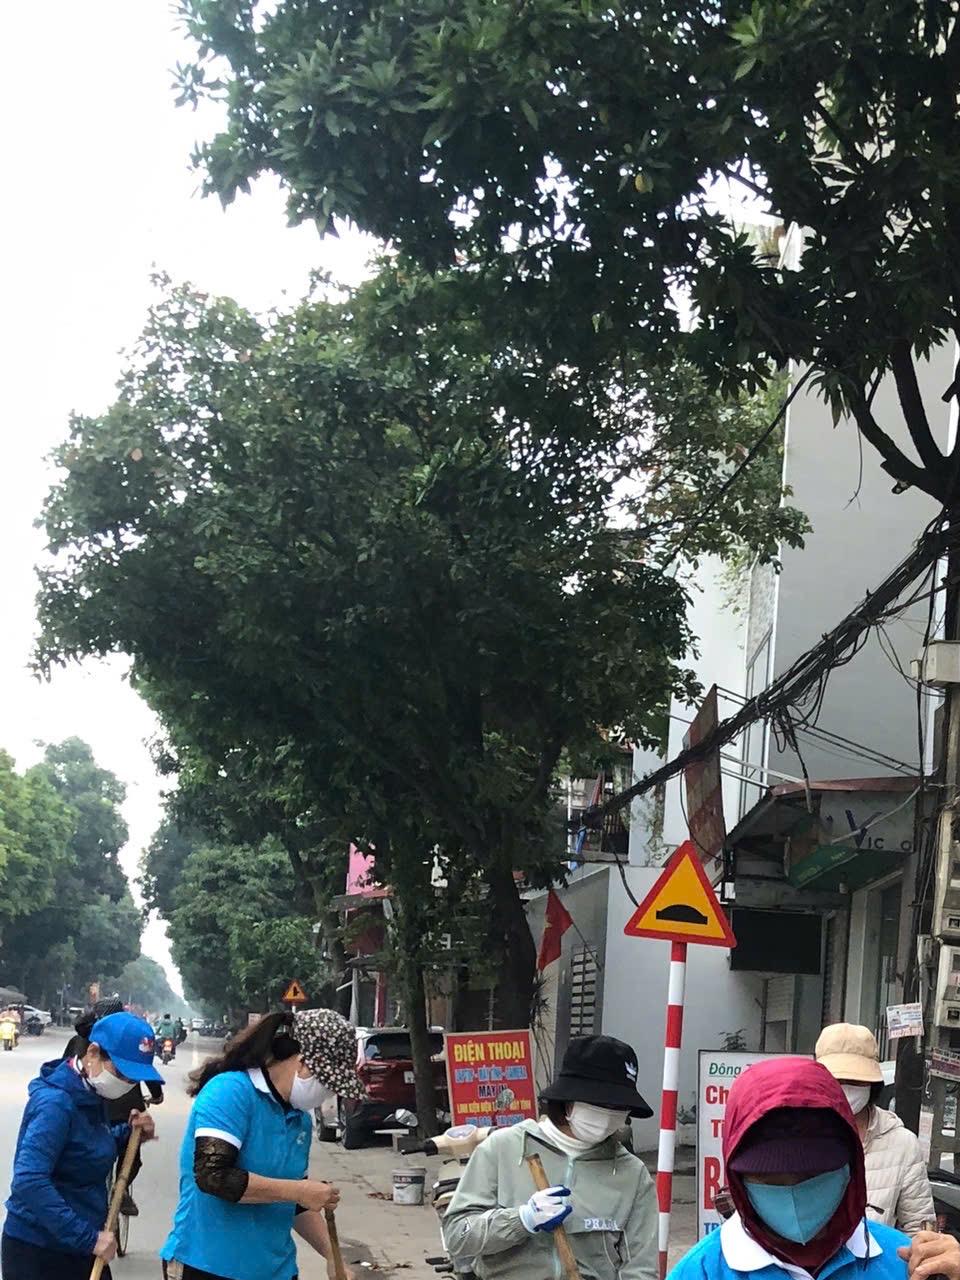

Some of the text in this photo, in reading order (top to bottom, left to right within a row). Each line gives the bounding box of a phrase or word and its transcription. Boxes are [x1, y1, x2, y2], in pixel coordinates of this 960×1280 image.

[454, 1040, 525, 1065] ĐIỆN THOẠI
[478, 1082, 496, 1098] MÁY
